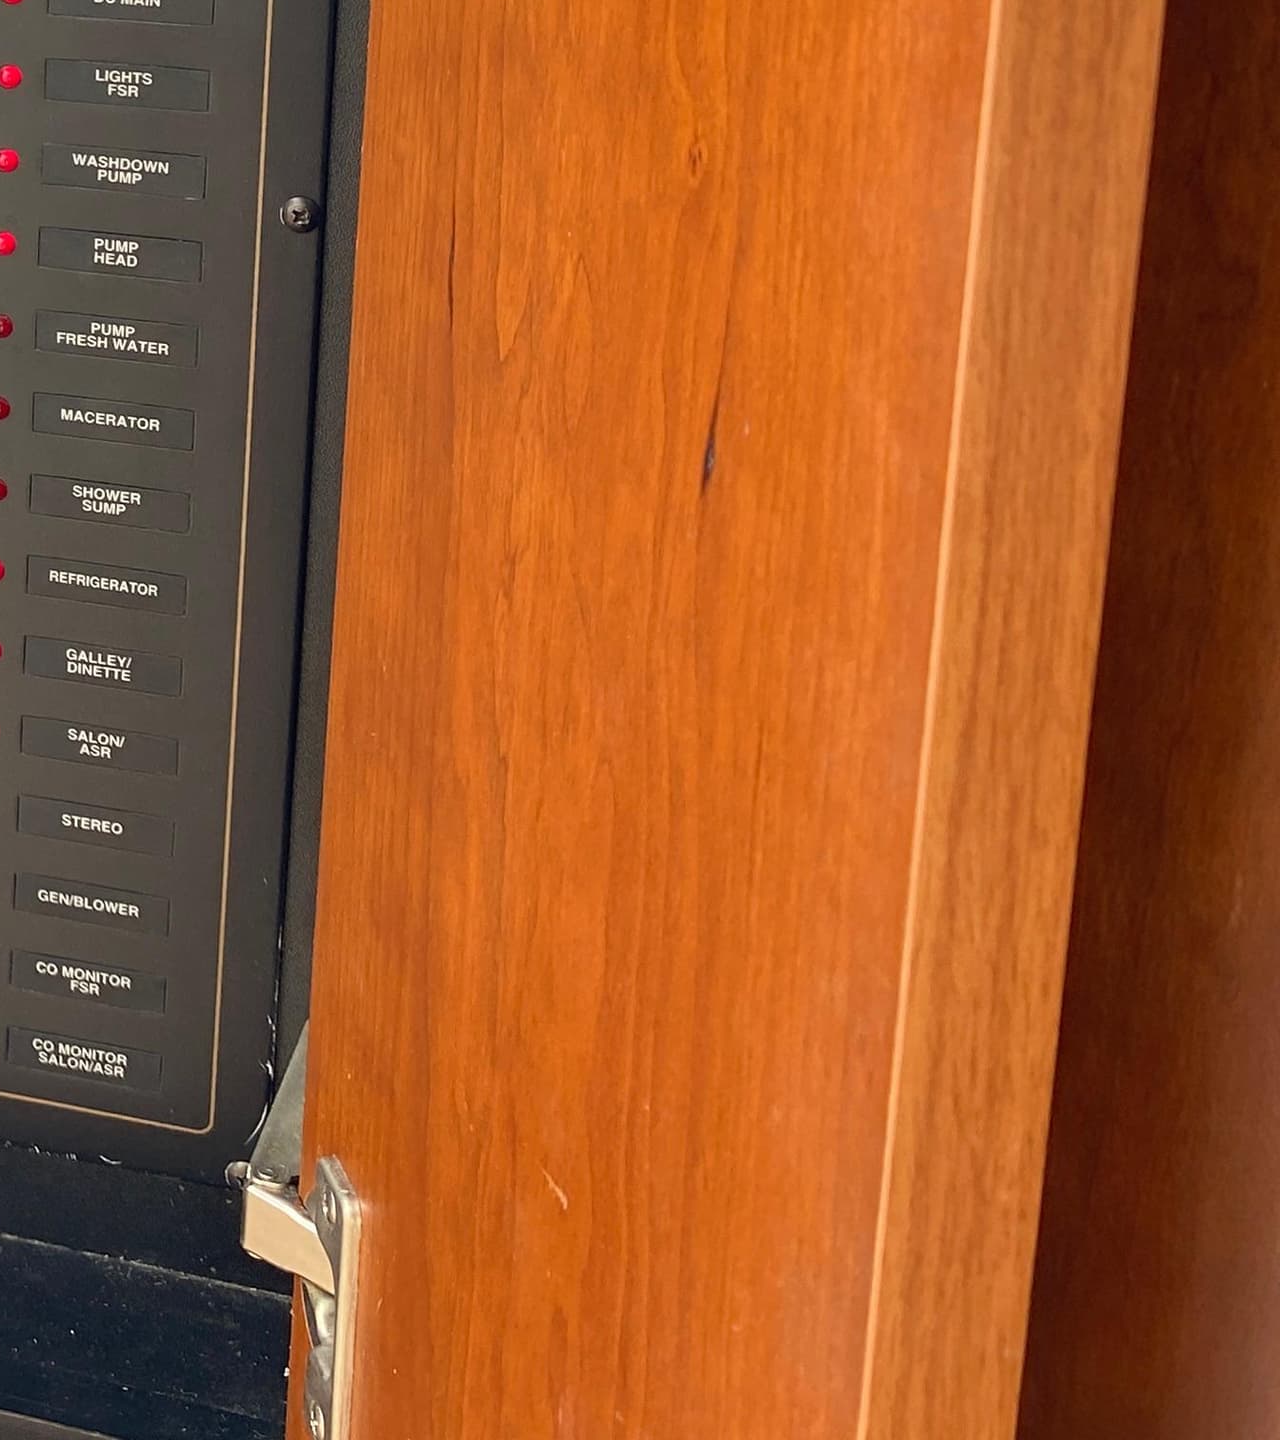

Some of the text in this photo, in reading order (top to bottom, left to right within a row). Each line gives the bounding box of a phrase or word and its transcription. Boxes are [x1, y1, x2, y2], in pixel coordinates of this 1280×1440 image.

[96, 70, 152, 85] LIGHTS
[108, 84, 138, 97] FSR
[73, 153, 169, 175] WASHDOWN
[98, 170, 142, 184] PUMP
[95, 238, 138, 253] PUMP
[94, 252, 137, 267] HEAD
[91, 323, 135, 337] PUMP
[57, 332, 168, 355] FRESH WATER
[61, 409, 159, 431] MACERATOR
[72, 485, 141, 505] SHOWER
[83, 500, 126, 515] SUMP
[50, 570, 157, 596] REFRIGERATOR
[66, 649, 131, 668] GALLEY/
[66, 661, 131, 682] DINETTE
[68, 729, 125, 747] SALON/
[80, 744, 111, 758] ASR
[62, 814, 122, 834] STEREO
[38, 890, 139, 917] GEN/BLOWER
[36, 962, 131, 989] CO MONITOR
[71, 980, 99, 995] FSR
[33, 1039, 127, 1068] CO MONITOR
[38, 1051, 125, 1078] SALON/ASR
